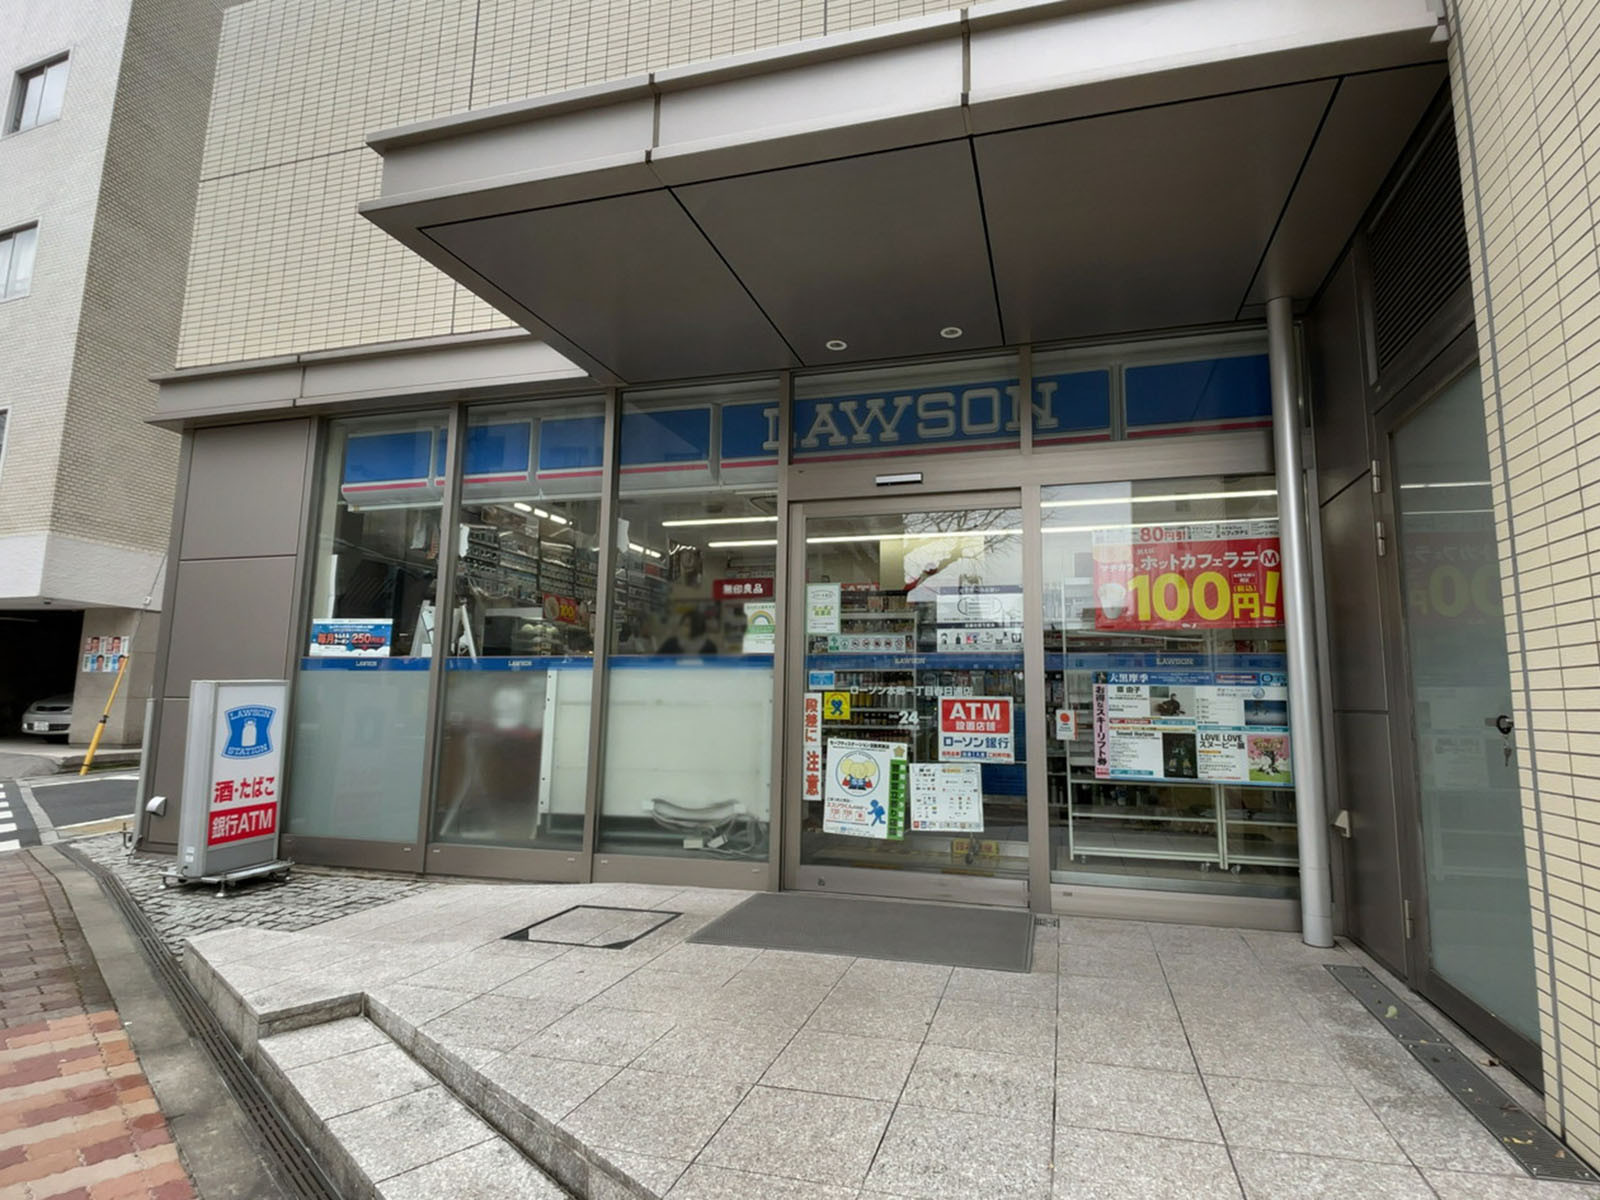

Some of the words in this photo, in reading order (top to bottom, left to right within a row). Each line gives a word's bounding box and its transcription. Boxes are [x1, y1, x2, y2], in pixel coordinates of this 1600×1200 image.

[763, 382, 1058, 451] LAWSON
[1140, 550, 1258, 571] ホットカフェラテ
[723, 583, 763, 595] 無印良品
[1156, 657, 1194, 665] LAWSON
[230, 709, 271, 720] LAWSON
[898, 711, 920, 724] 24
[949, 702, 1000, 721] ATM
[943, 736, 1009, 749] ローソン銀行
[1201, 734, 1221, 742] LOVE
[227, 744, 268, 755] STATION
[214, 776, 275, 803] 酒・たばこ
[211, 808, 273, 839] 銀行ATM
